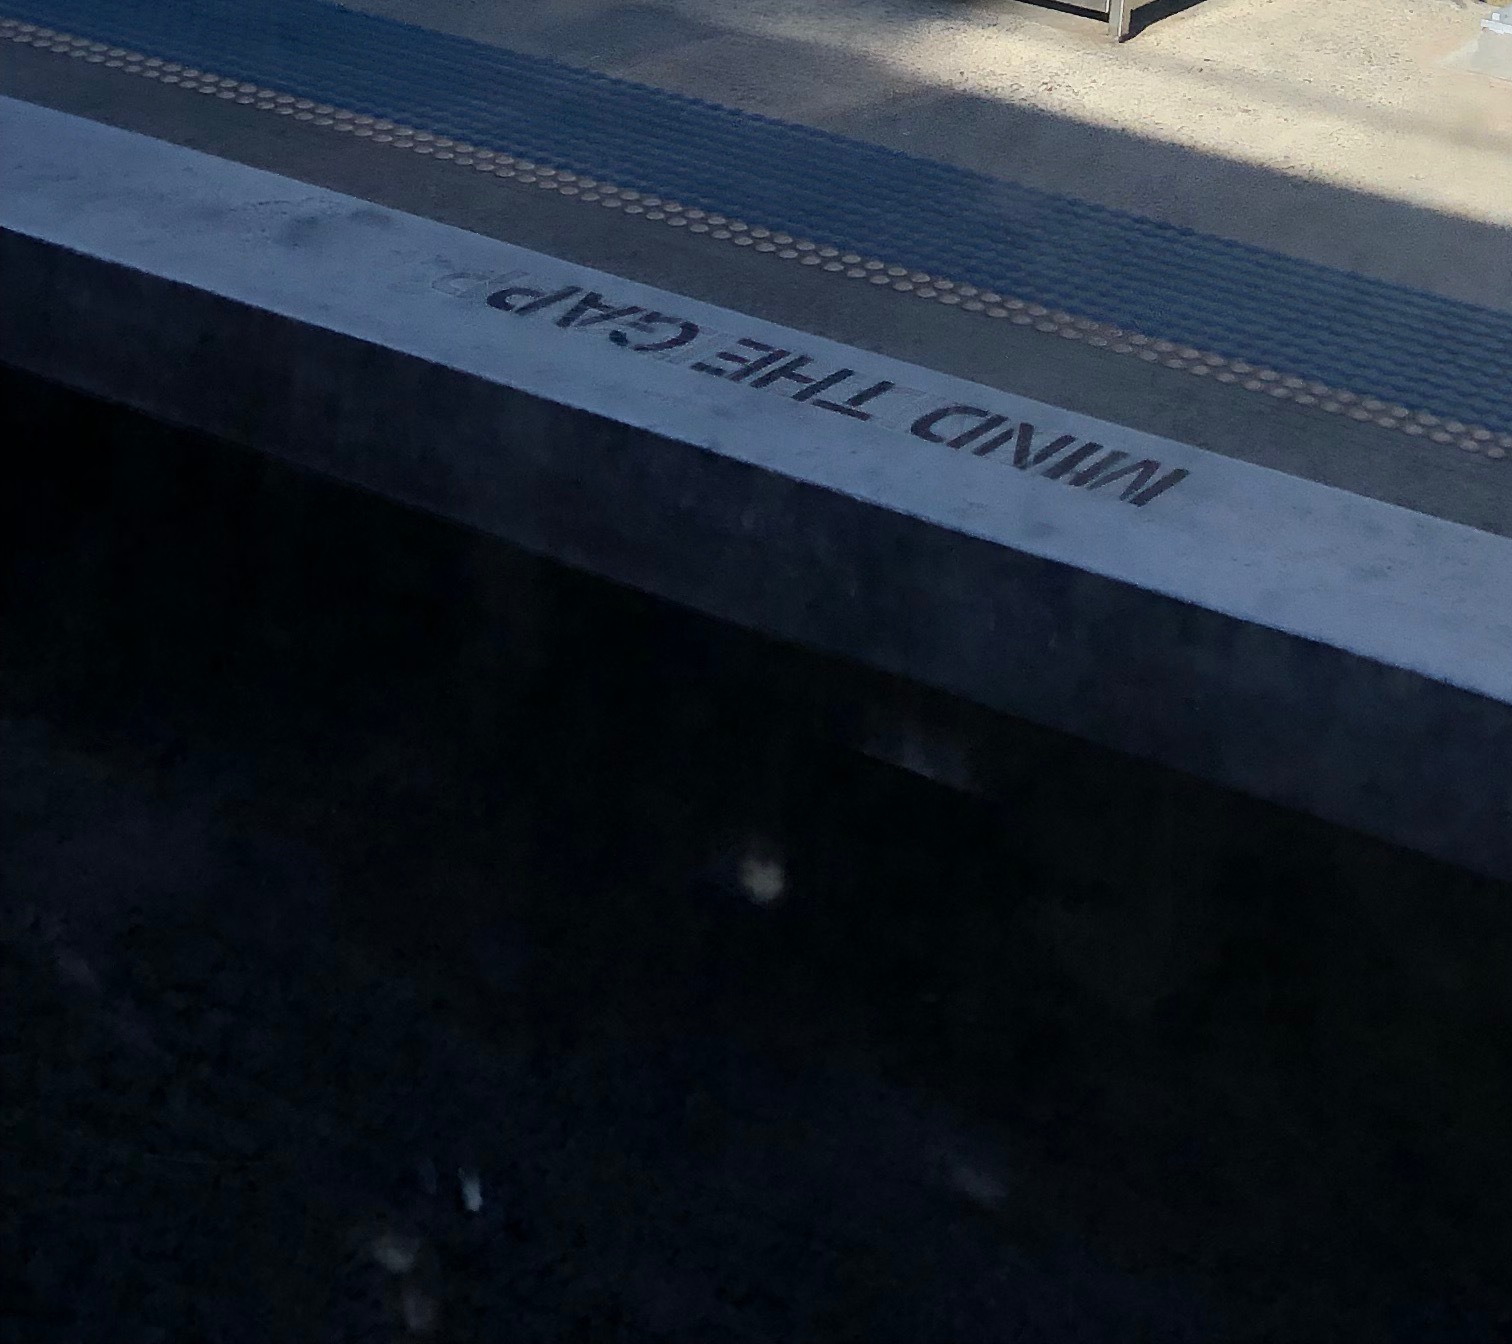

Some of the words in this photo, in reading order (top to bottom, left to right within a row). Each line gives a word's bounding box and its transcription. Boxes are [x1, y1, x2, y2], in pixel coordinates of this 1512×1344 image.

[486, 285, 700, 353] GAP
[690, 337, 896, 422] THE
[908, 404, 1190, 508] MIND
